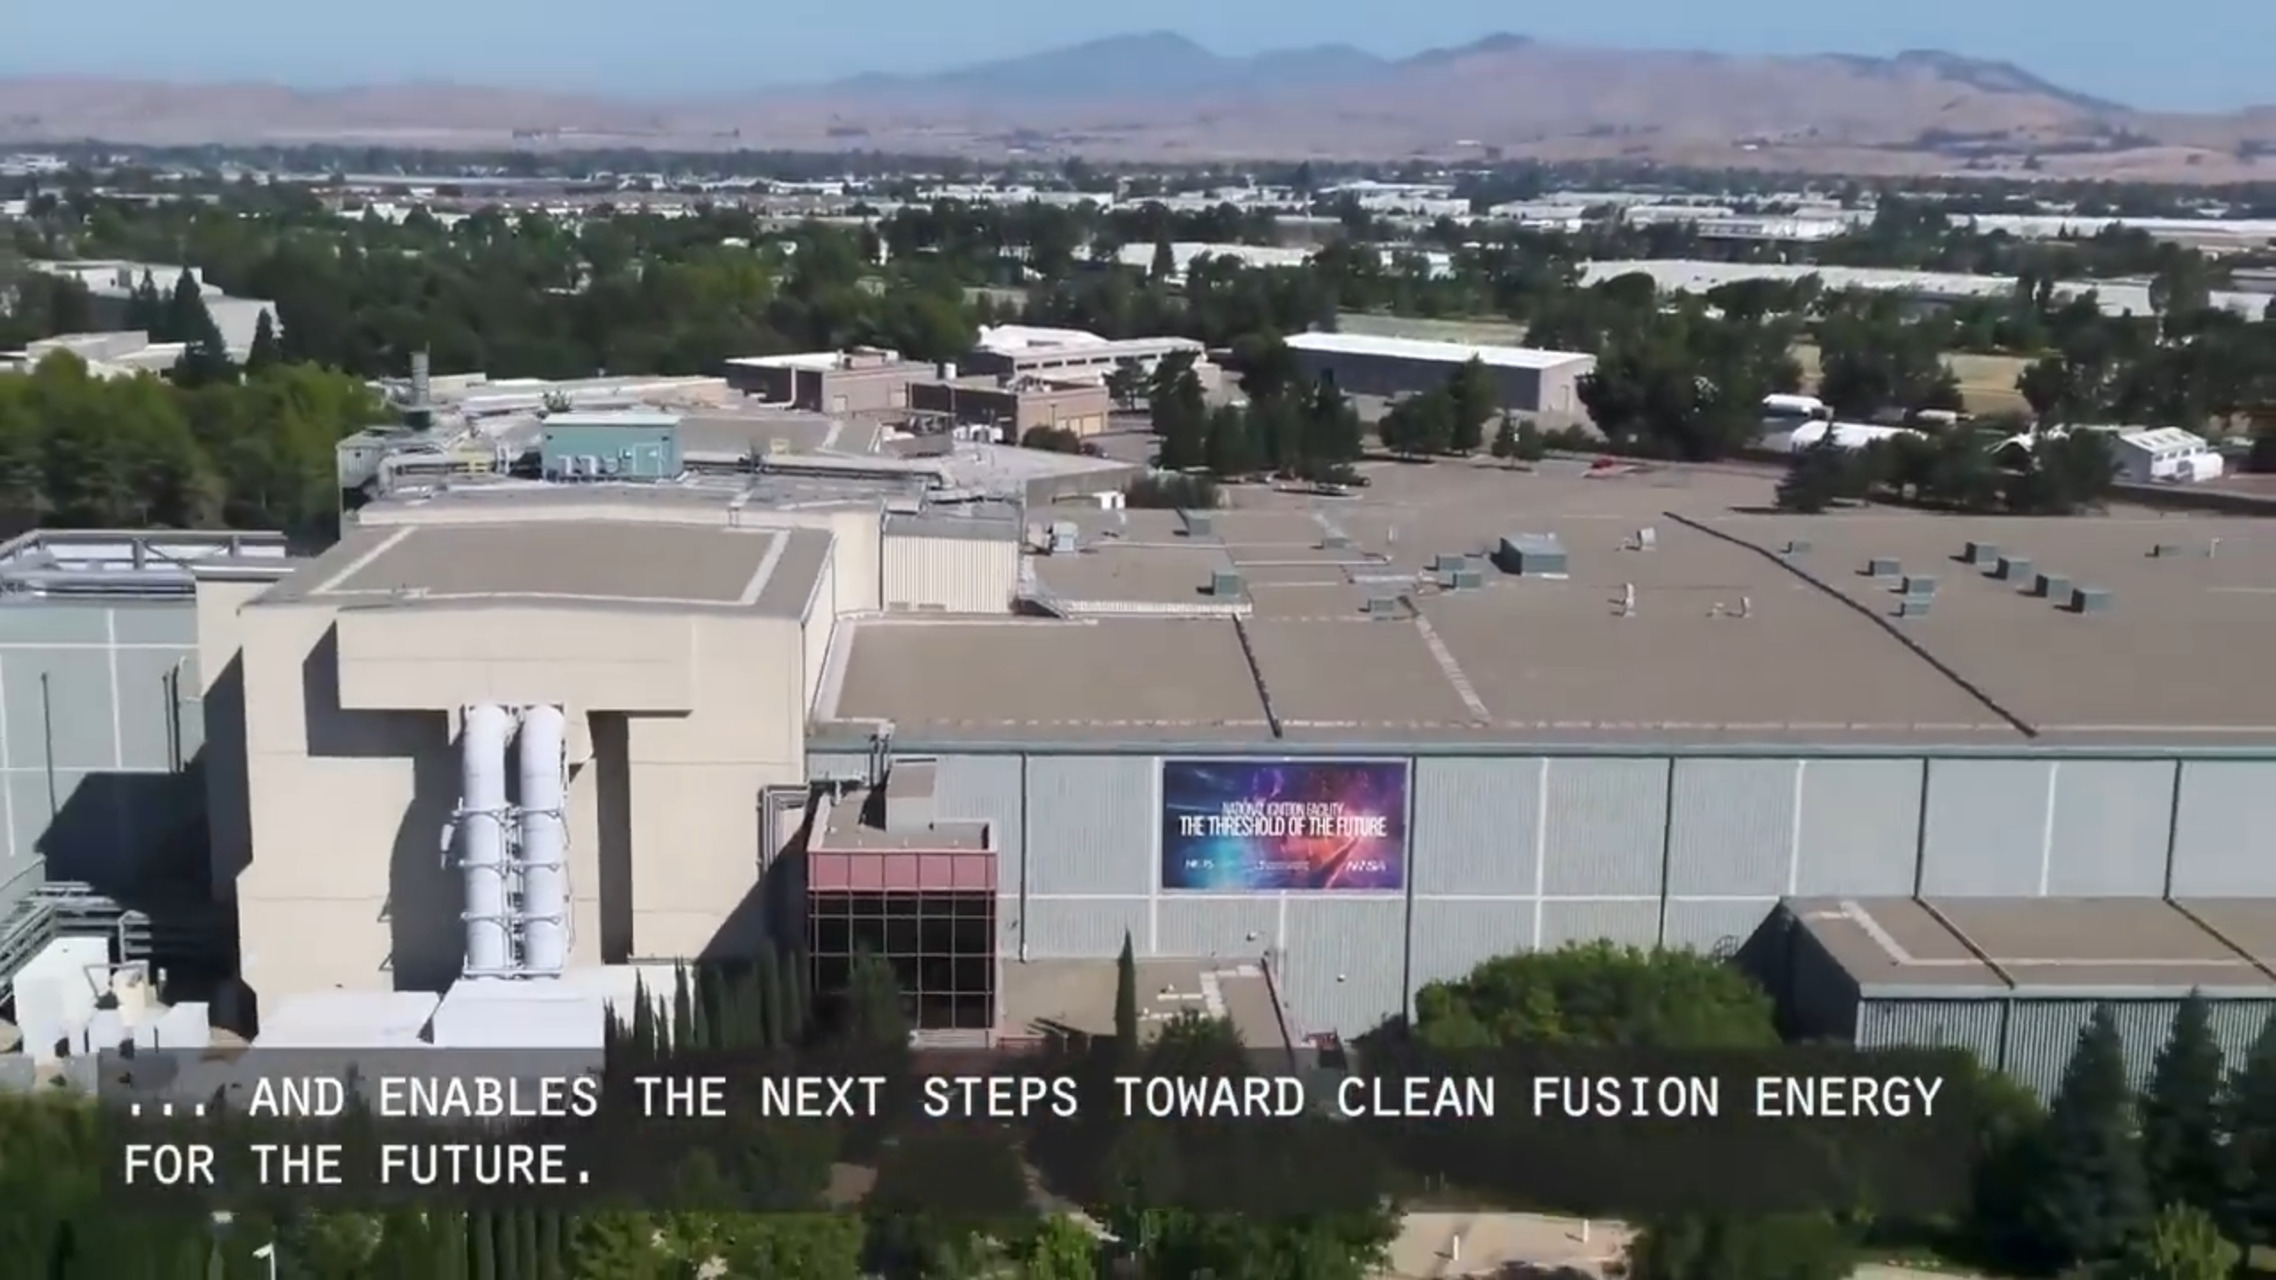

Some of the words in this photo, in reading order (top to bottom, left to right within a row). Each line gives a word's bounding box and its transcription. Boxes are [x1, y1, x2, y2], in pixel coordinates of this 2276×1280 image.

[1222, 801, 1264, 816] NATIONAL
[1267, 802, 1305, 816] IGNITION
[1307, 801, 1345, 816] FACILITY
[1179, 815, 1204, 837] THE
[1209, 815, 1285, 837] THRESHOLD
[1289, 815, 1305, 837] OF
[1308, 815, 1335, 837] THE
[1336, 815, 1388, 837] FUTURE
